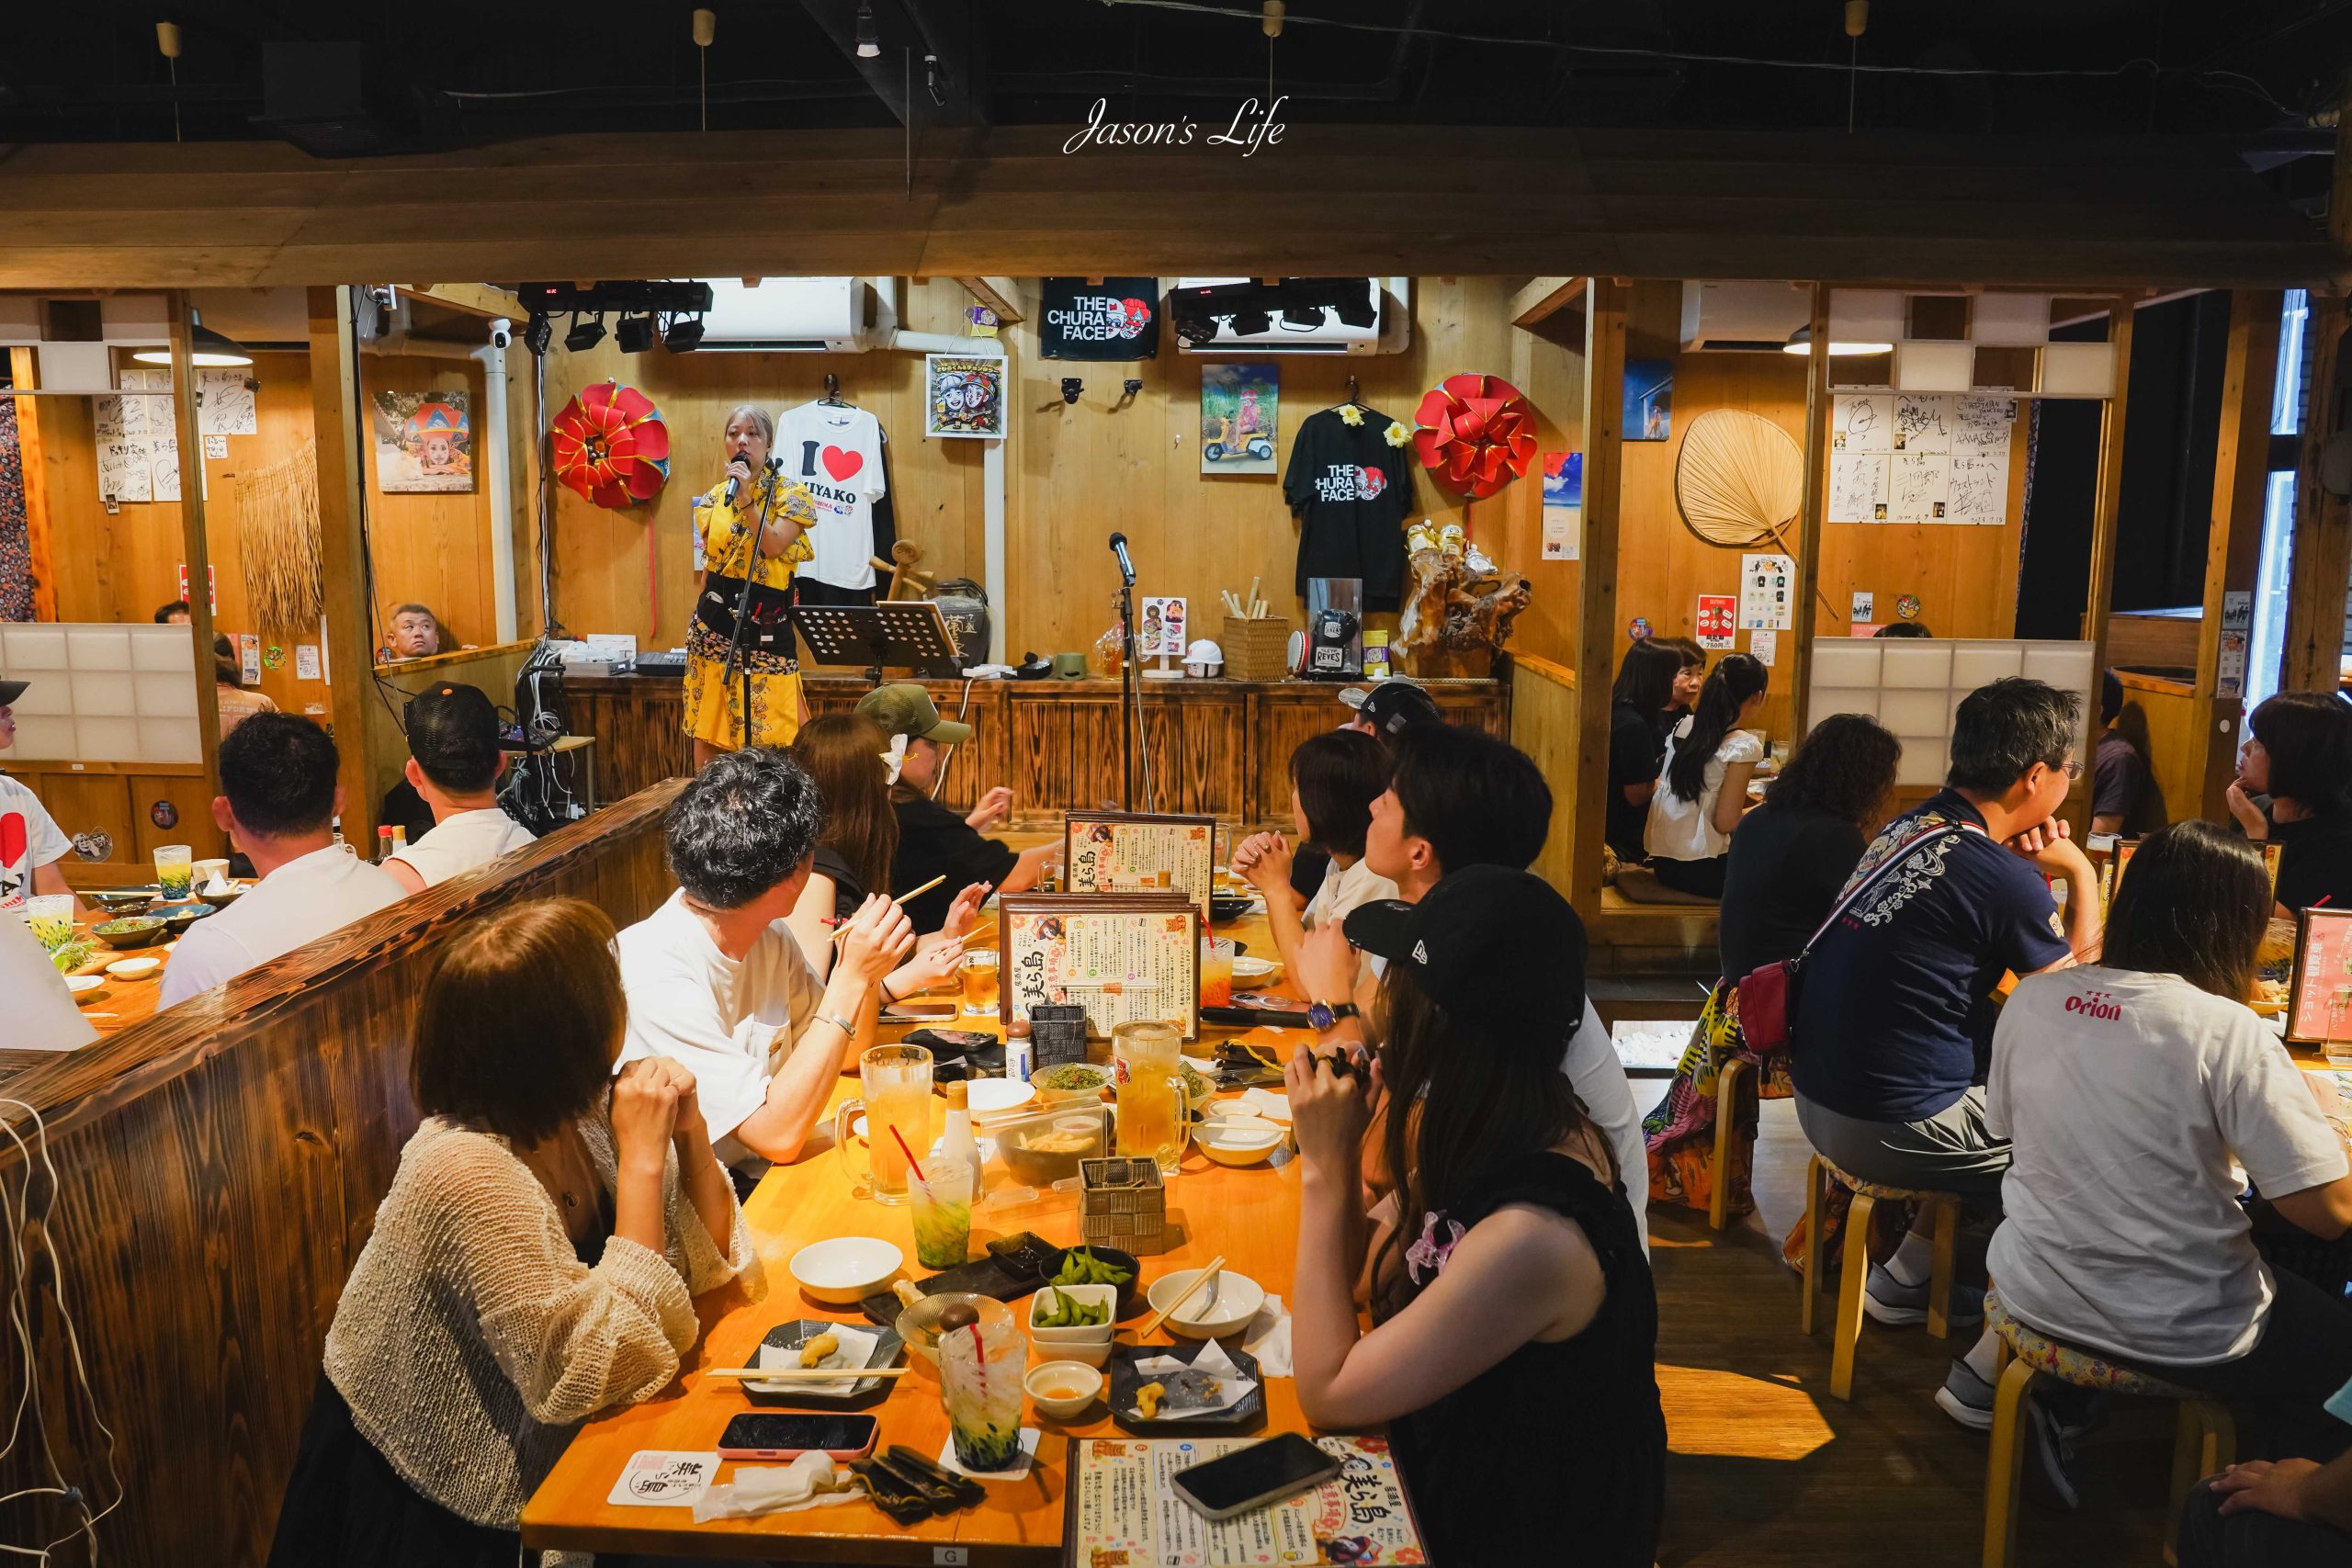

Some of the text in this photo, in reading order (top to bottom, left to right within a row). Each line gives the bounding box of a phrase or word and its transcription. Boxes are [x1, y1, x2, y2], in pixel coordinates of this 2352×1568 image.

[1073, 296, 1106, 311] THE
[1047, 309, 1105, 326] CHURA
[1062, 325, 1105, 341] FACE
[801, 440, 820, 477] I
[1327, 464, 1355, 477] THE
[1314, 477, 1355, 491] HURA
[1320, 489, 1355, 502] FACE
[1317, 651, 1340, 662] REYES
[1078, 851, 1096, 888] 美ら島
[1021, 951, 1046, 998] 美ら島
[1047, 957, 1058, 992] 注意事項
[2300, 942, 2324, 1023] ショット観覧車
[2064, 996, 2121, 1021] Orion
[1340, 1473, 1392, 1524] 美ら島
[1384, 1485, 1402, 1506] 居酒屋
[945, 1550, 956, 1563] G
